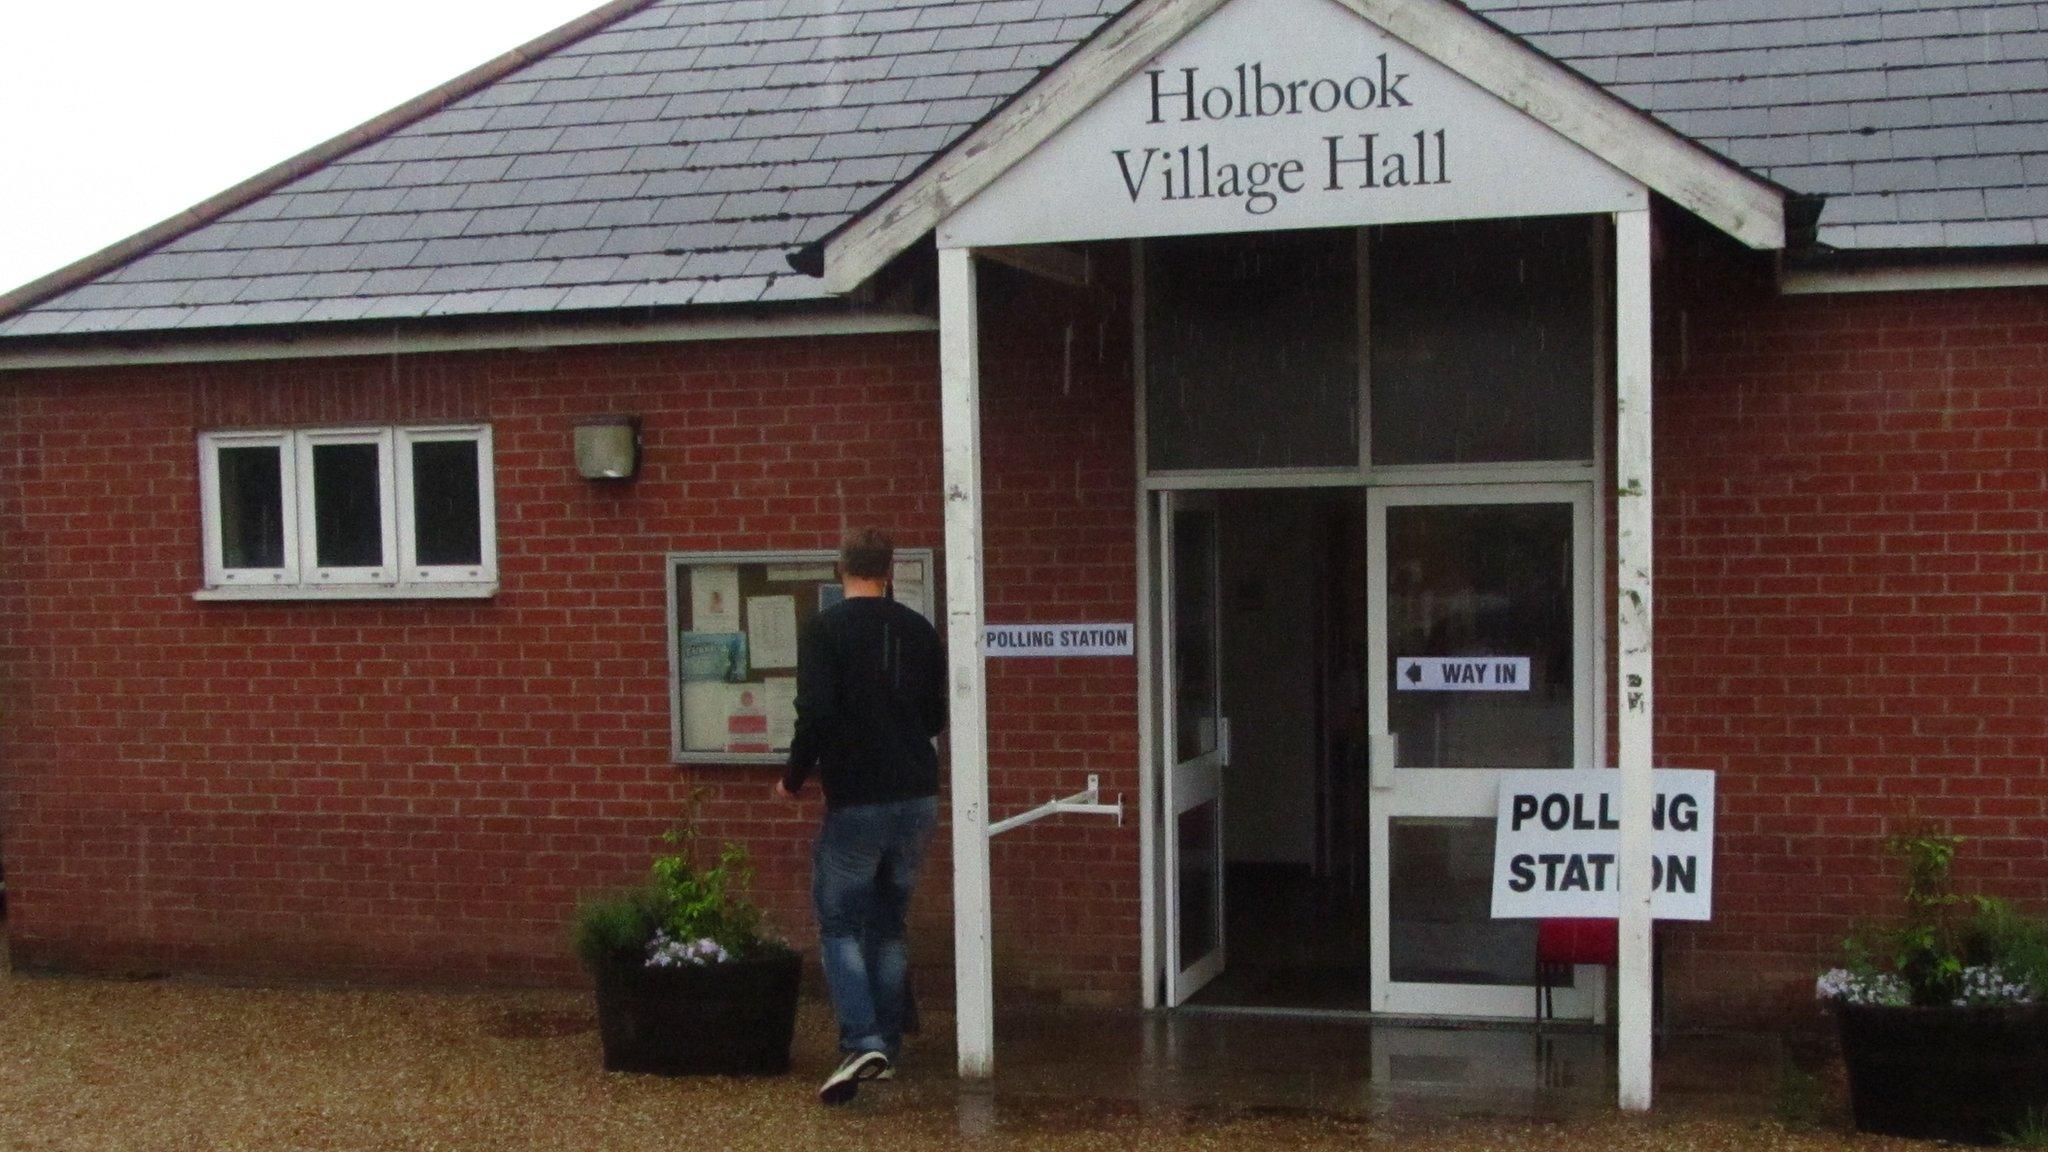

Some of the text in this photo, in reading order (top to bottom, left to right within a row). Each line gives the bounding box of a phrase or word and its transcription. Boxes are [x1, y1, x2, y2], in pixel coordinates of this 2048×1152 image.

[1145, 52, 1413, 123] Holbrook
[1112, 128, 1451, 214] Village Hall
[986, 629, 1127, 648] POLLING STATION
[1441, 663, 1516, 684] WAY IN
[1511, 793, 1698, 832] POLLG
[1508, 854, 1696, 893] STATN
